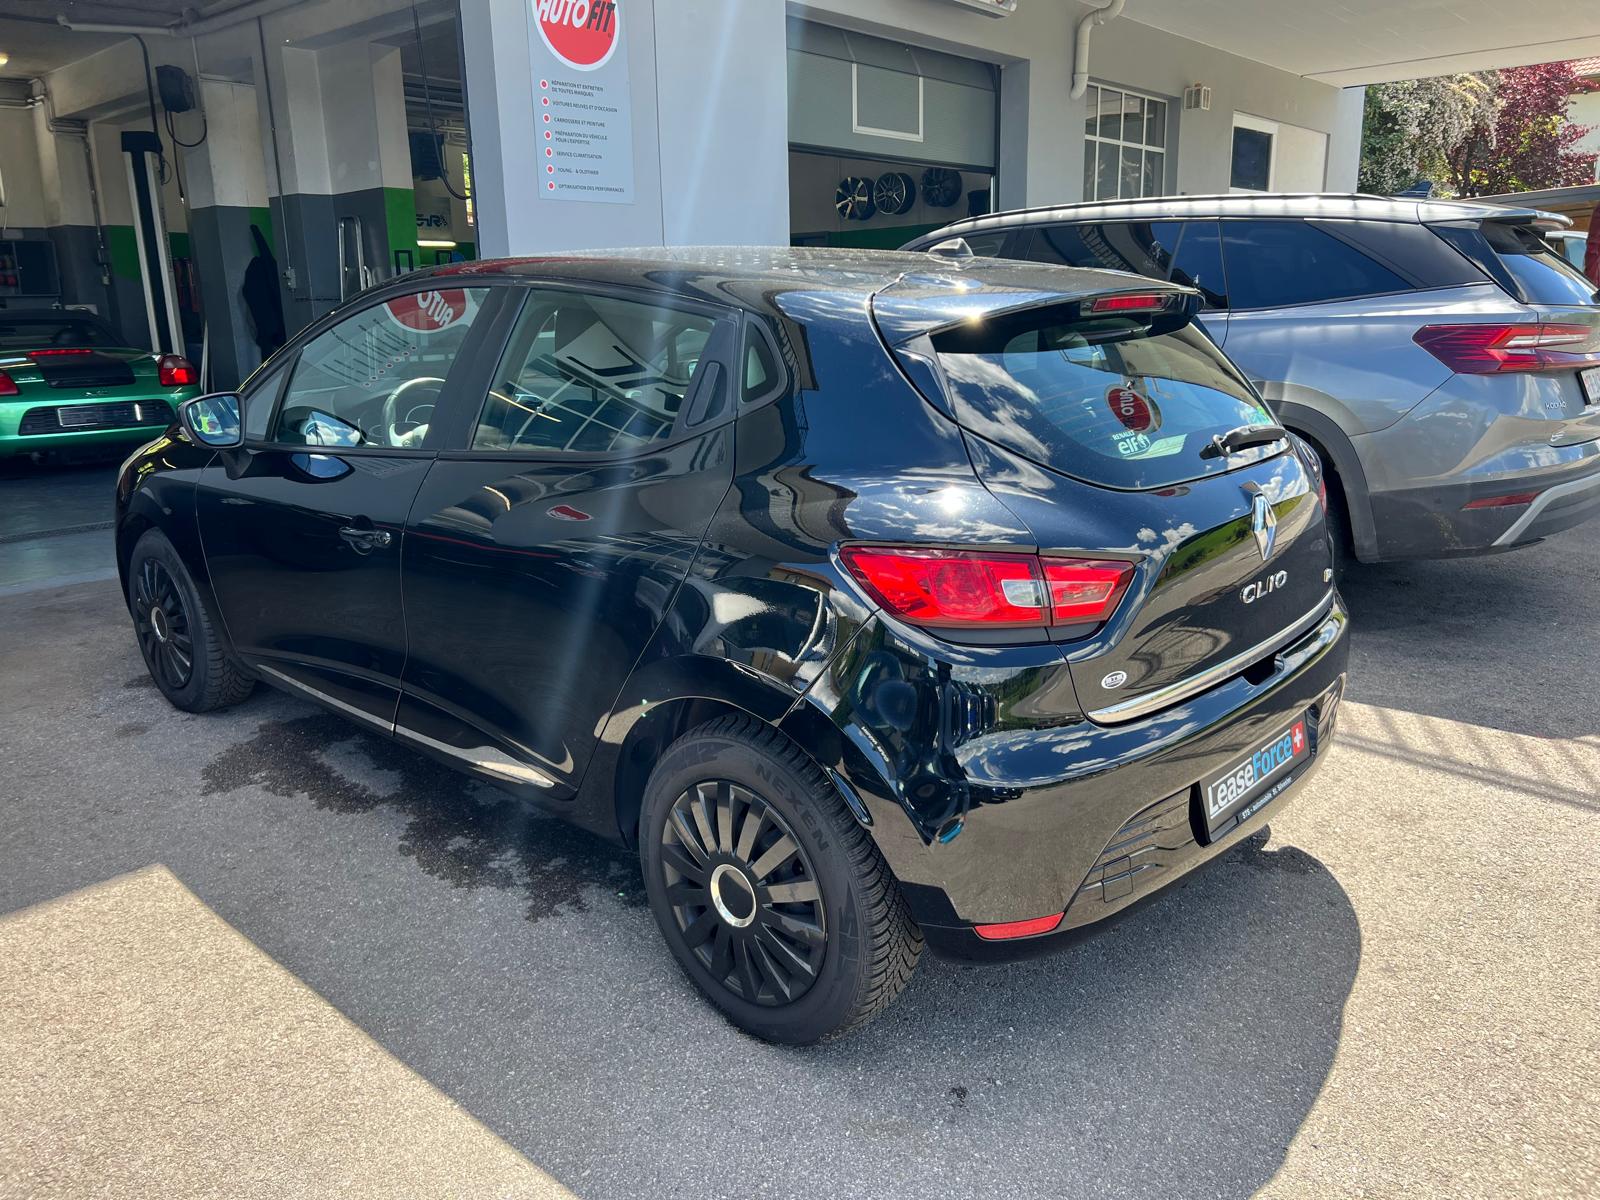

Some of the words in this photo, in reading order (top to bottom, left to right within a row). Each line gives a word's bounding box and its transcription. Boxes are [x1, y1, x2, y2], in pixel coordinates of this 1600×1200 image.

[558, 87, 574, 95] TOUTES
[573, 152, 603, 160] CLIMATISATION
[1112, 431, 1135, 441] RENAULT
[1118, 437, 1138, 454] elf
[1240, 570, 1288, 604] CLIO
[1207, 734, 1292, 815] LeaseForce
[755, 763, 830, 851] NEXEN
